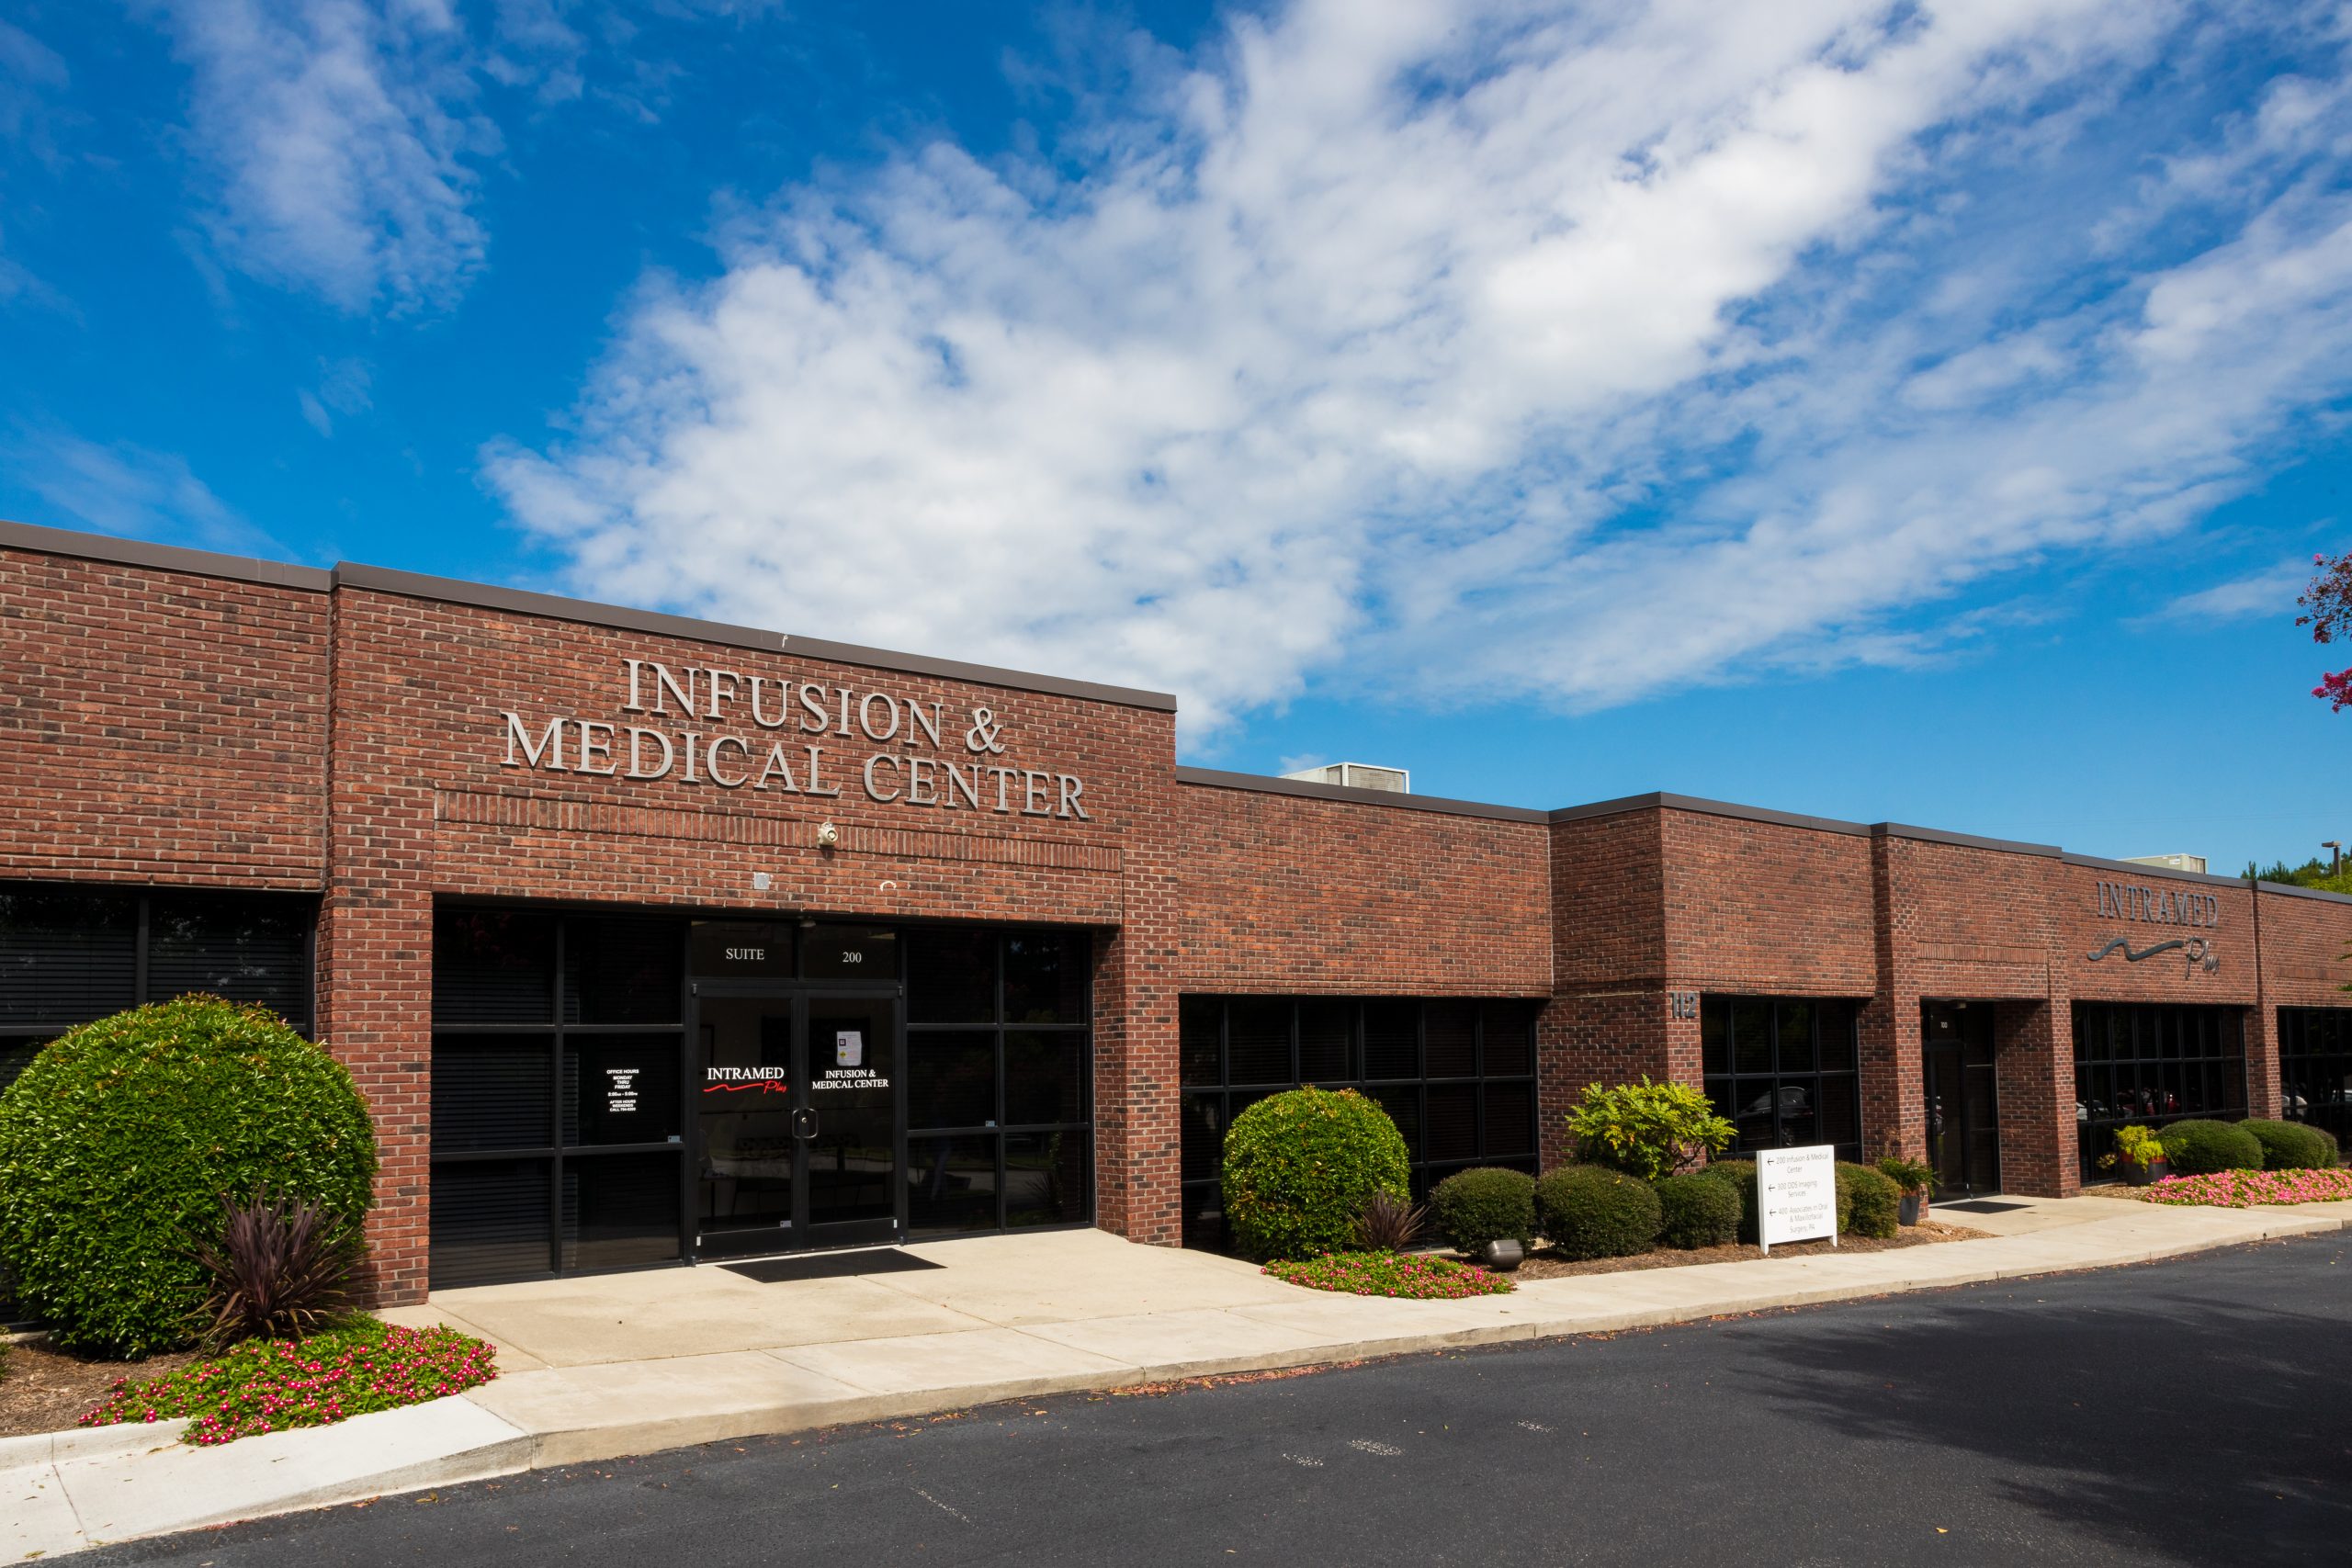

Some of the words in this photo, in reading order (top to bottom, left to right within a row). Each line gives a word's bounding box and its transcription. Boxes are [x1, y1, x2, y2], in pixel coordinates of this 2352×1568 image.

[623, 659, 943, 750] INFUSION
[966, 707, 1005, 754] &
[500, 711, 842, 797] MEDICAL
[863, 753, 1090, 819] CENTER
[2096, 881, 2219, 928] INTRAMED
[726, 948, 764, 960] SUITE
[842, 952, 862, 963] 200
[2185, 936, 2221, 980] Plus
[1670, 991, 1697, 1018] 112
[707, 1067, 785, 1080] INTRAMED
[826, 1070, 867, 1078] INFUSION
[868, 1069, 876, 1077] &
[763, 1080, 787, 1094] Plus
[812, 1080, 853, 1089] MEDICAL
[854, 1078, 889, 1088] CENTER
[1776, 1156, 1786, 1165] 200
